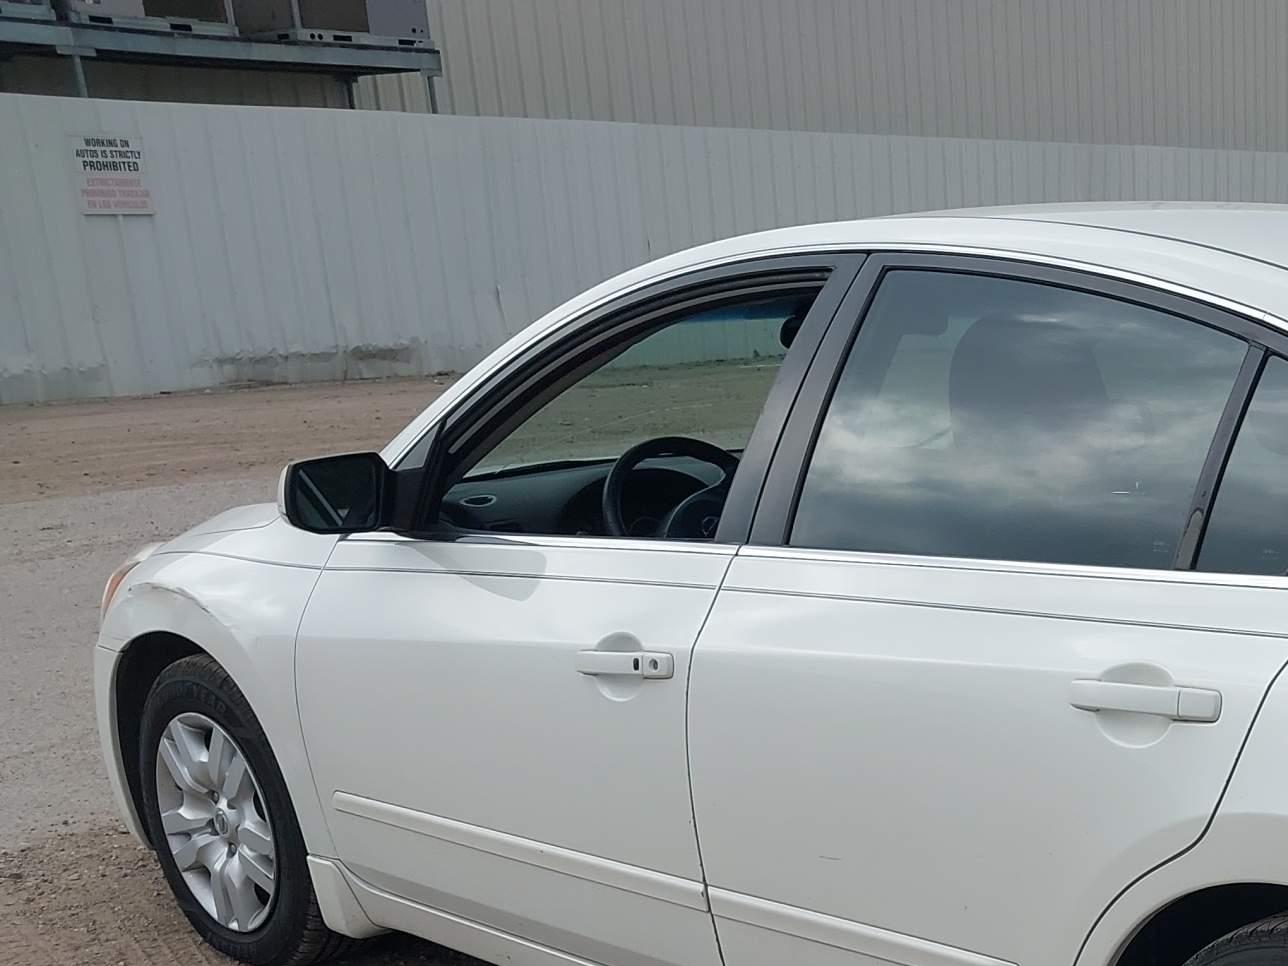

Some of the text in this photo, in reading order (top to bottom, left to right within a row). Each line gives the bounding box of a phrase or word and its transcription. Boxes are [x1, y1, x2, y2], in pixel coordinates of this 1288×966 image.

[83, 138, 130, 148] WORKING ON
[75, 149, 141, 159] AUTOS IS STRICTLY
[82, 160, 139, 172] PROHIBITED
